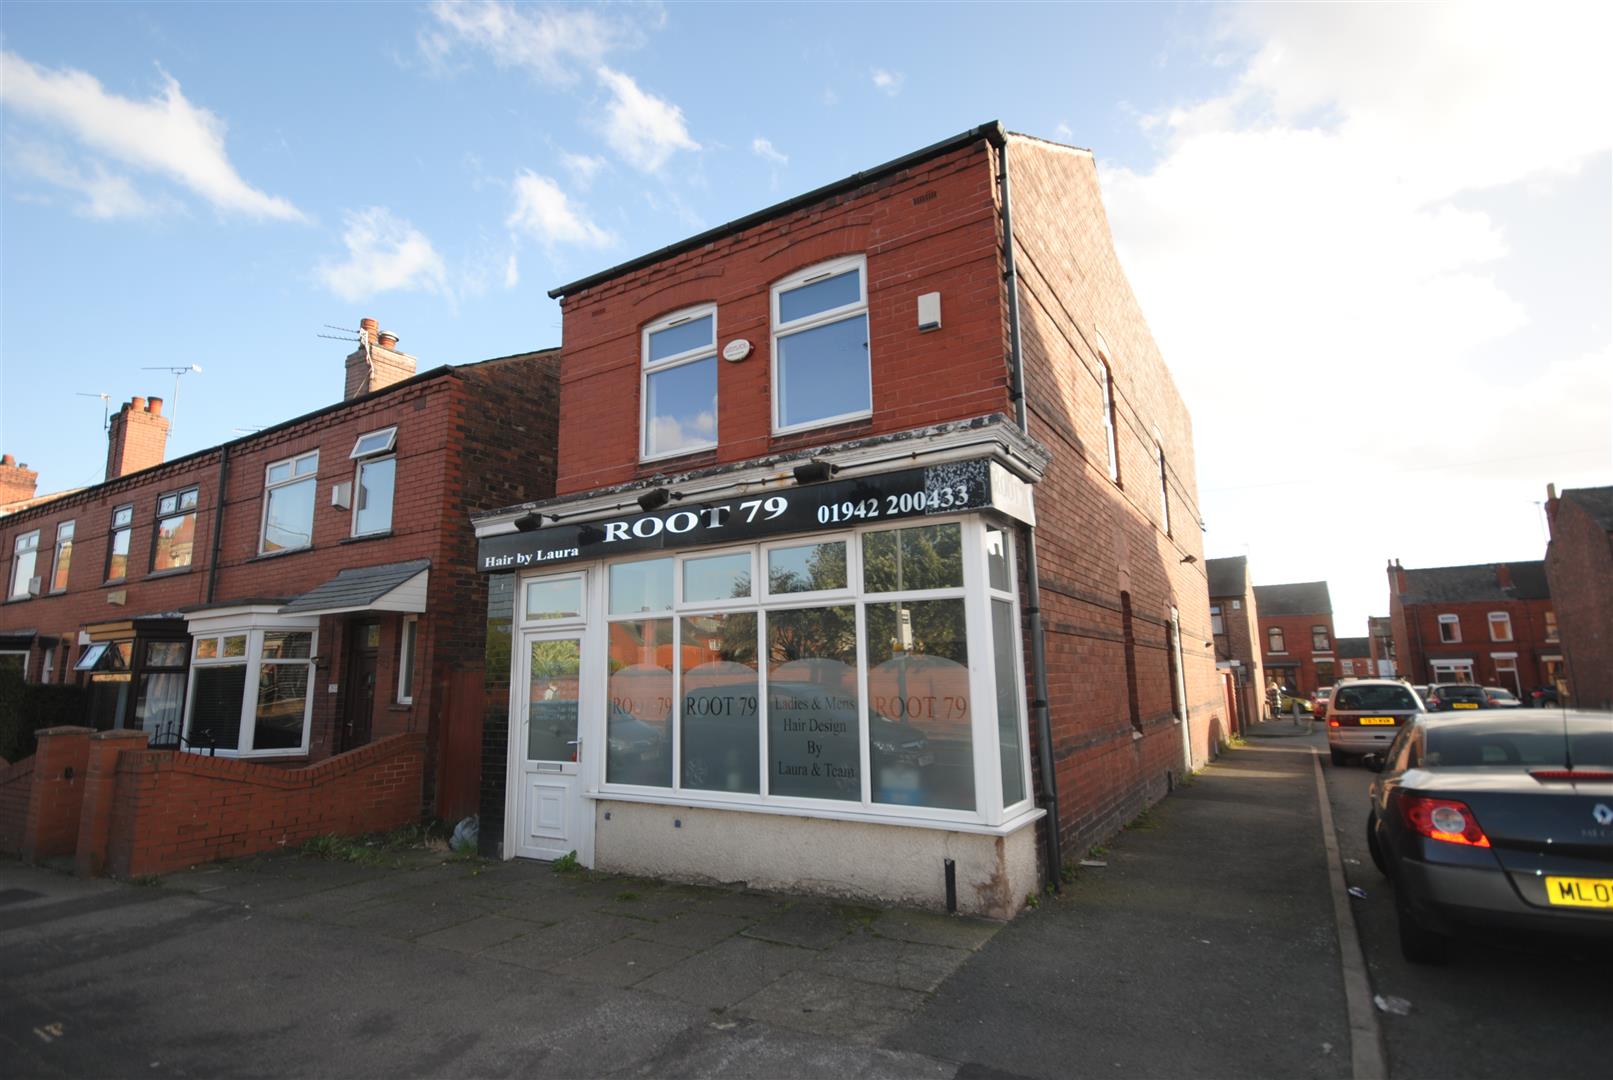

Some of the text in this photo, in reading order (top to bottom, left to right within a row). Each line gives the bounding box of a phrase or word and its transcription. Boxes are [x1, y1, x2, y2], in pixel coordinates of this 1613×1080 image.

[817, 485, 969, 524] 01942 200433
[602, 496, 788, 543] ROOT 79
[485, 547, 579, 568] Hair by Laura
[613, 697, 656, 715] RO
[687, 696, 757, 716] ROOT 79
[775, 696, 809, 710] Ladies
[811, 696, 821, 710] &
[876, 696, 967, 719] ROOT 79
[783, 718, 847, 736] Hair Design
[807, 740, 822, 758] By
[778, 761, 856, 778] Laura & Team
[1558, 881, 1613, 903] ML0
